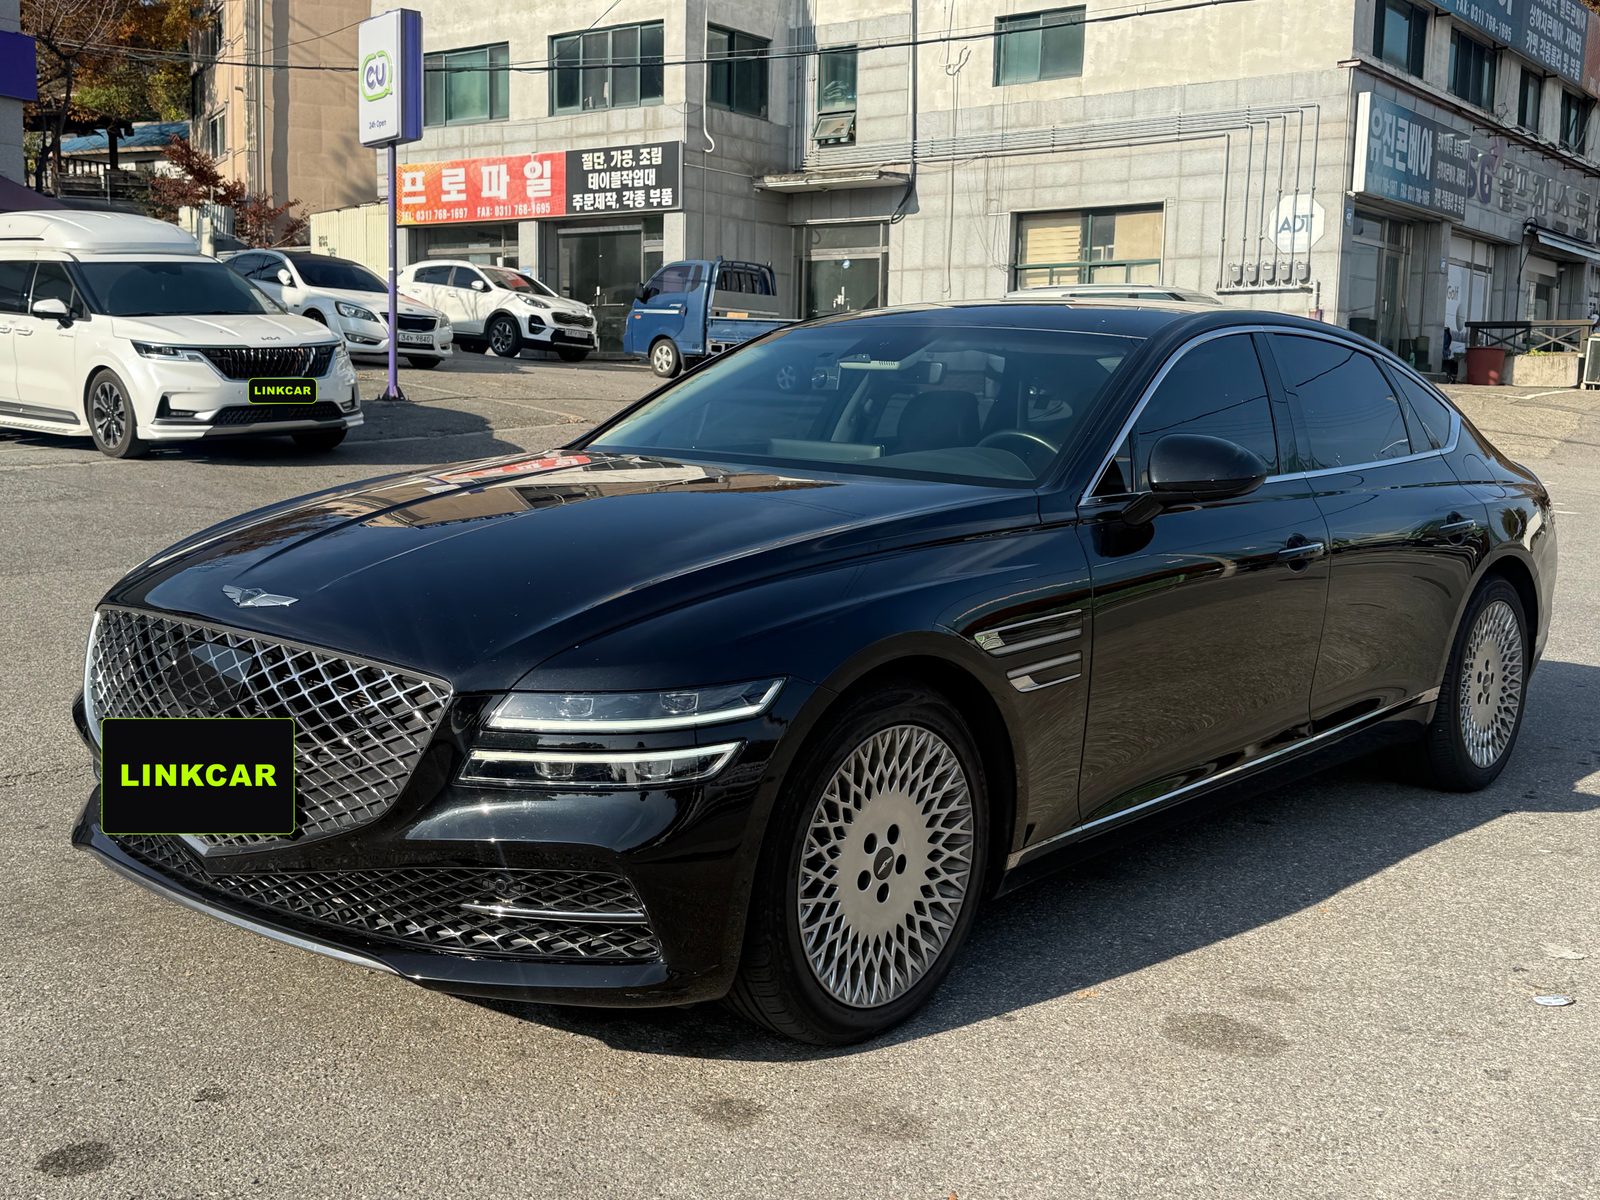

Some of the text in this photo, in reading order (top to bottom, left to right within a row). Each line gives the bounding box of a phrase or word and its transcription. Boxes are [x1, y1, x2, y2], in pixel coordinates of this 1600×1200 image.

[366, 63, 386, 90] CU
[1570, 57, 1581, 81] 부품
[1369, 107, 1433, 181] 유진콘베아
[581, 147, 662, 171] 절단, 가공, 조립
[402, 160, 551, 205] 프로파일
[587, 168, 656, 190] 테이블작업대
[572, 188, 673, 211] 주문제작, 각종 부품
[416, 210, 432, 222] 031)
[434, 207, 468, 220] 768-1697
[477, 206, 493, 217] FAX:
[494, 204, 512, 217] 031)
[514, 202, 551, 216] 768-1695
[1278, 214, 1314, 234] ADT
